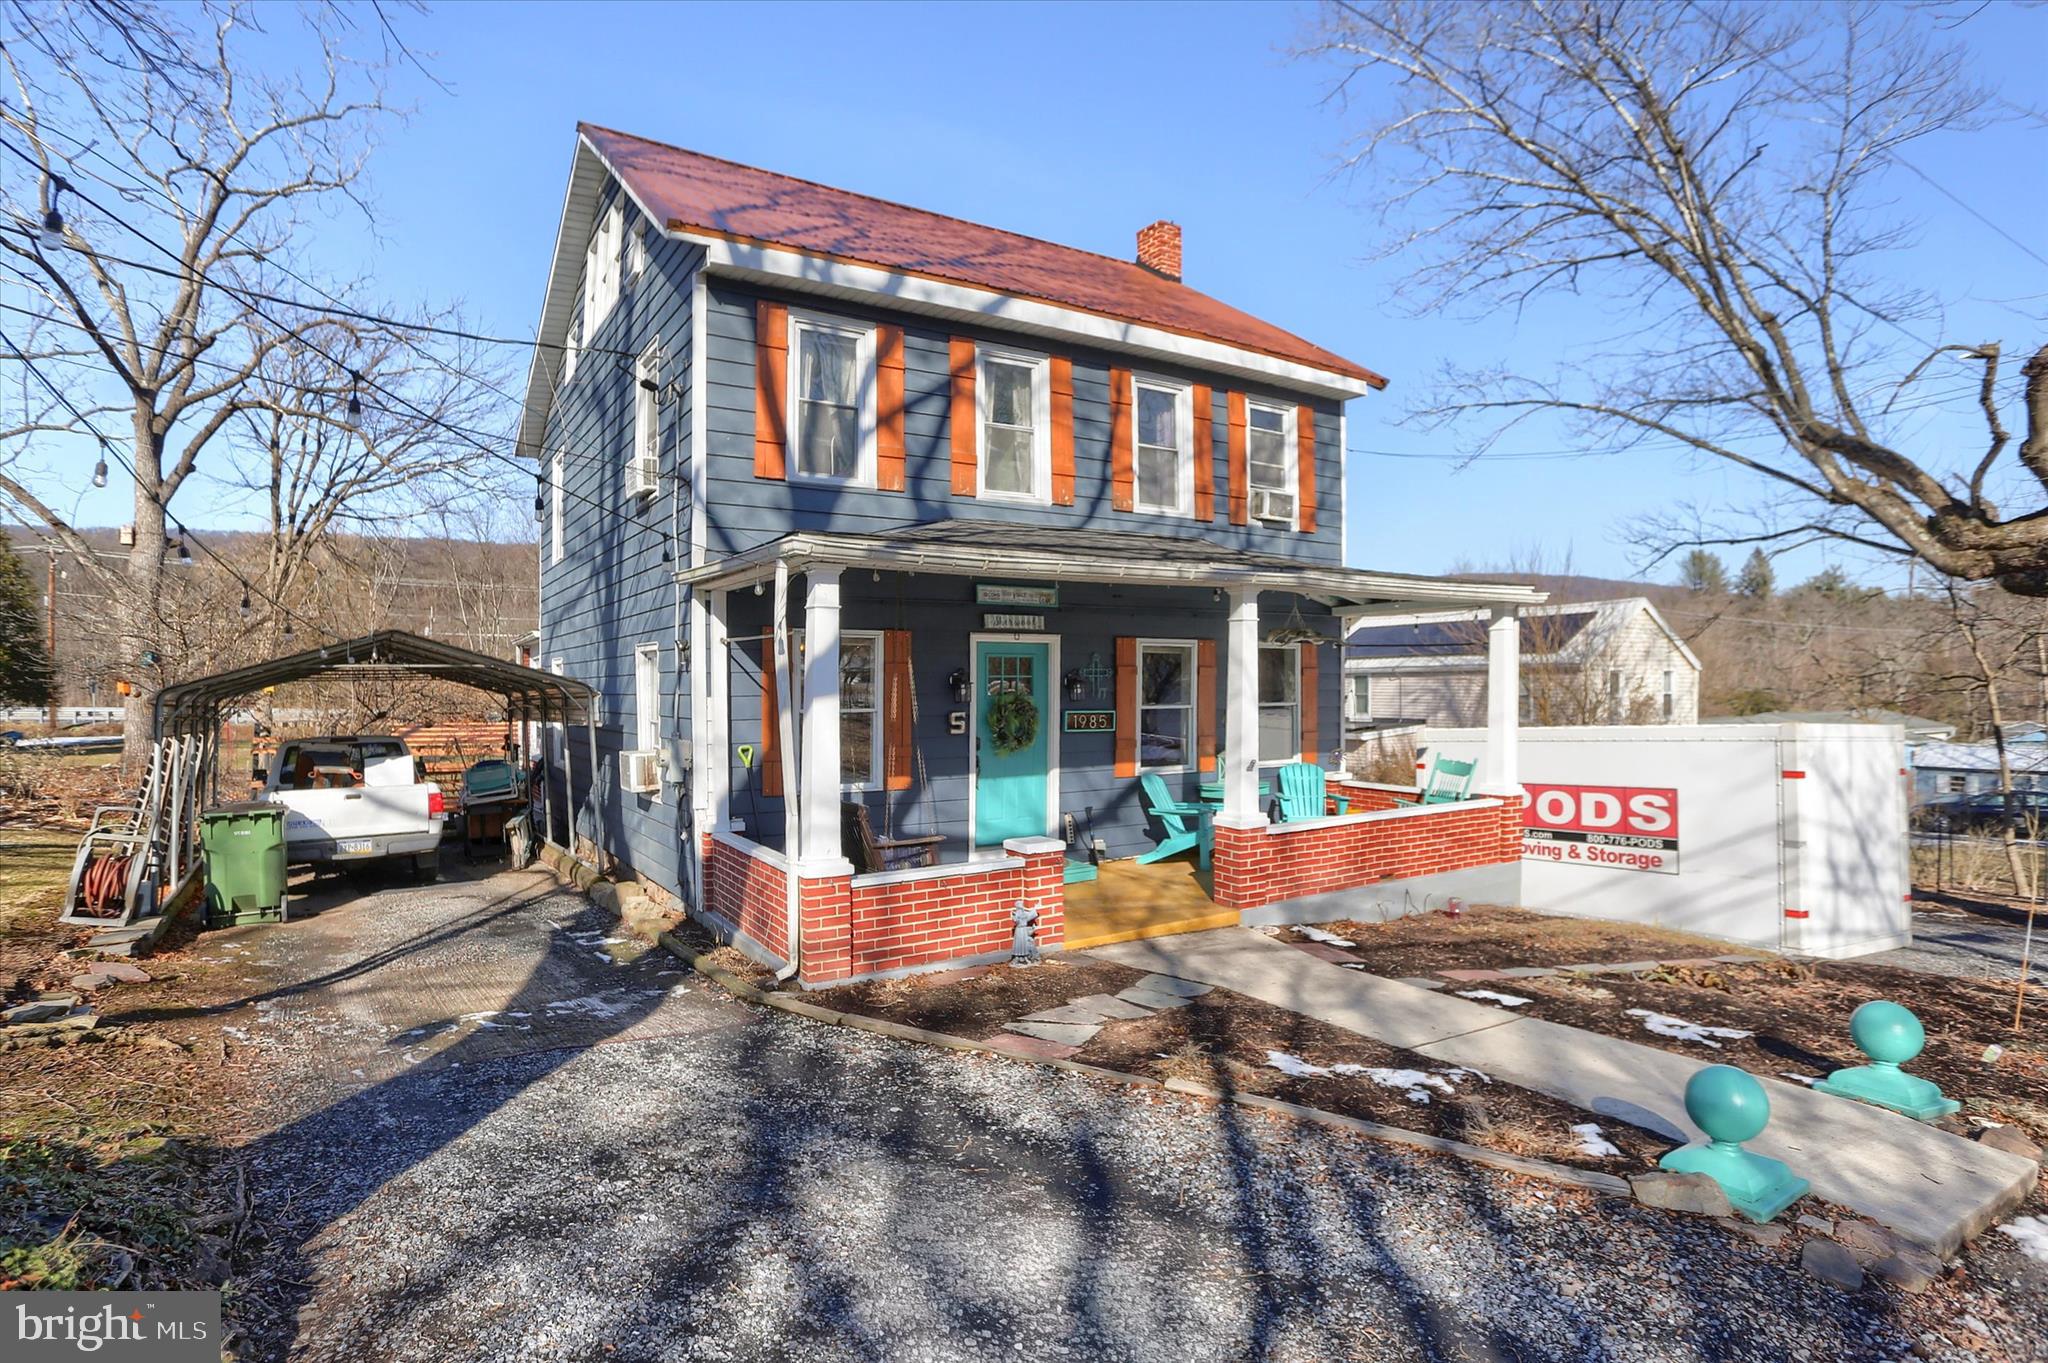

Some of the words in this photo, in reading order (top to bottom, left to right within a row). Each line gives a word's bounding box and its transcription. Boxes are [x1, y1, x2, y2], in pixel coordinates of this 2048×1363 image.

[1073, 714, 1107, 729] 1985
[1522, 789, 1672, 832] ODS
[1585, 833, 1664, 849] 800-776-PODS
[1520, 841, 1562, 861] oving
[1567, 844, 1581, 859] &
[1586, 845, 1663, 869] Storage
